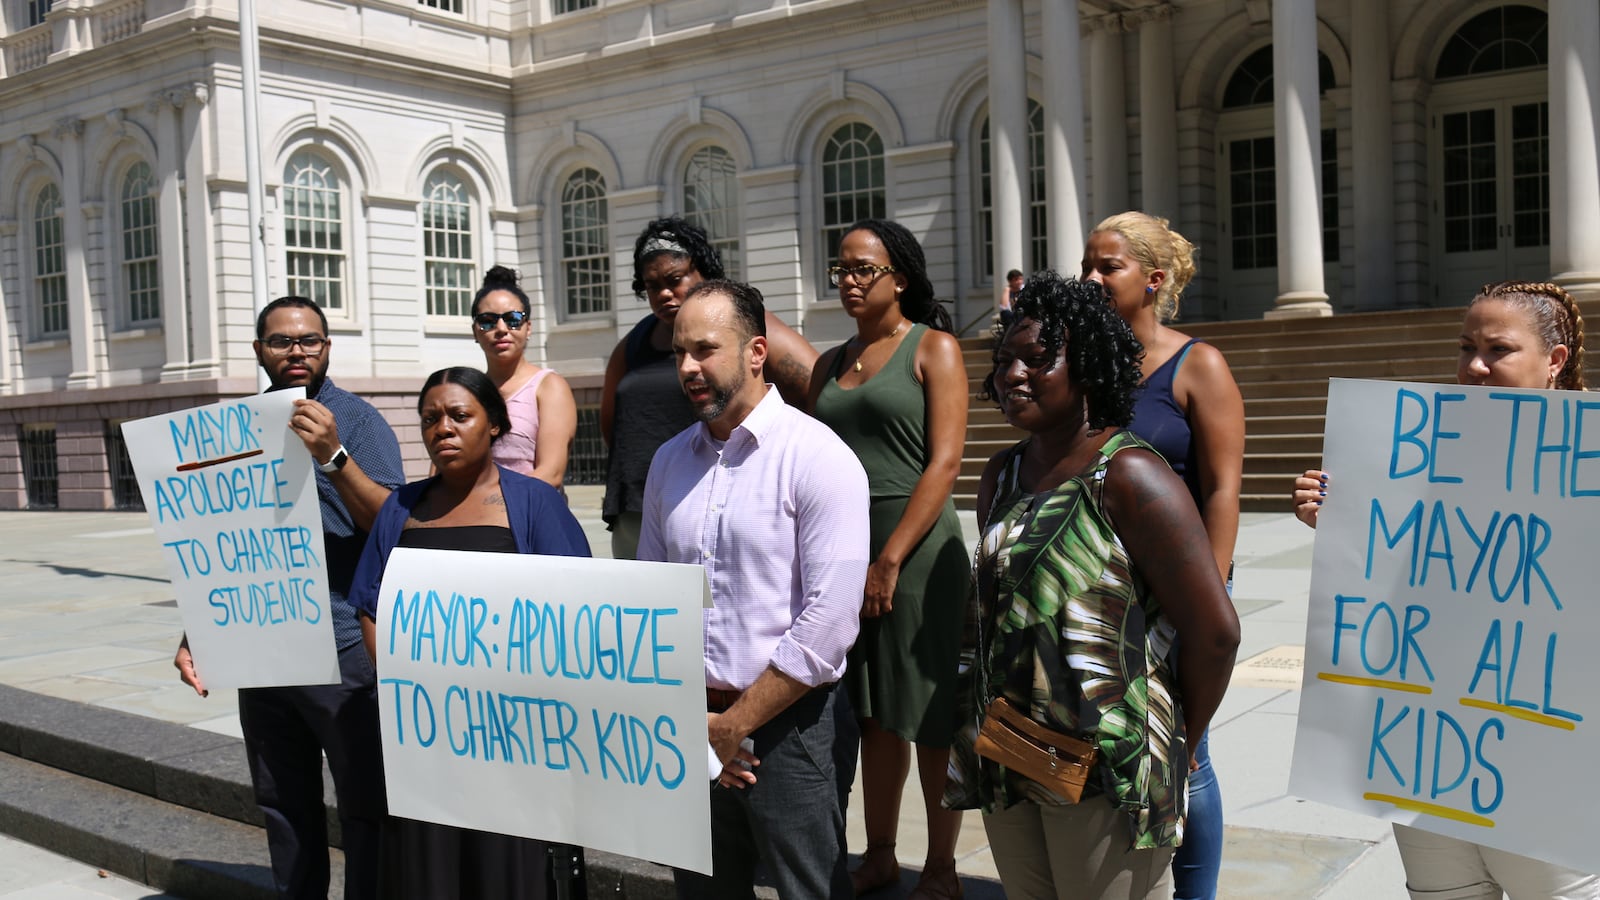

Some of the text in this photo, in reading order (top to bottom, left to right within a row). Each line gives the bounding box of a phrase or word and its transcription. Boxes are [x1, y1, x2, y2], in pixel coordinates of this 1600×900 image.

[169, 403, 263, 463] MAYOR:
[1389, 387, 1600, 499] BE THE
[153, 458, 294, 524] APOLOGIZE
[163, 525, 321, 580] TO CHARTER
[208, 577, 322, 627] STUDENTS
[1364, 497, 1563, 611] MAYOR
[390, 589, 684, 686] MAYOR: APOLOGIZE
[1331, 594, 1584, 722] FOR ALL
[380, 678, 686, 790] TO CHARTER KIDS
[1366, 696, 1505, 815] KIDS
